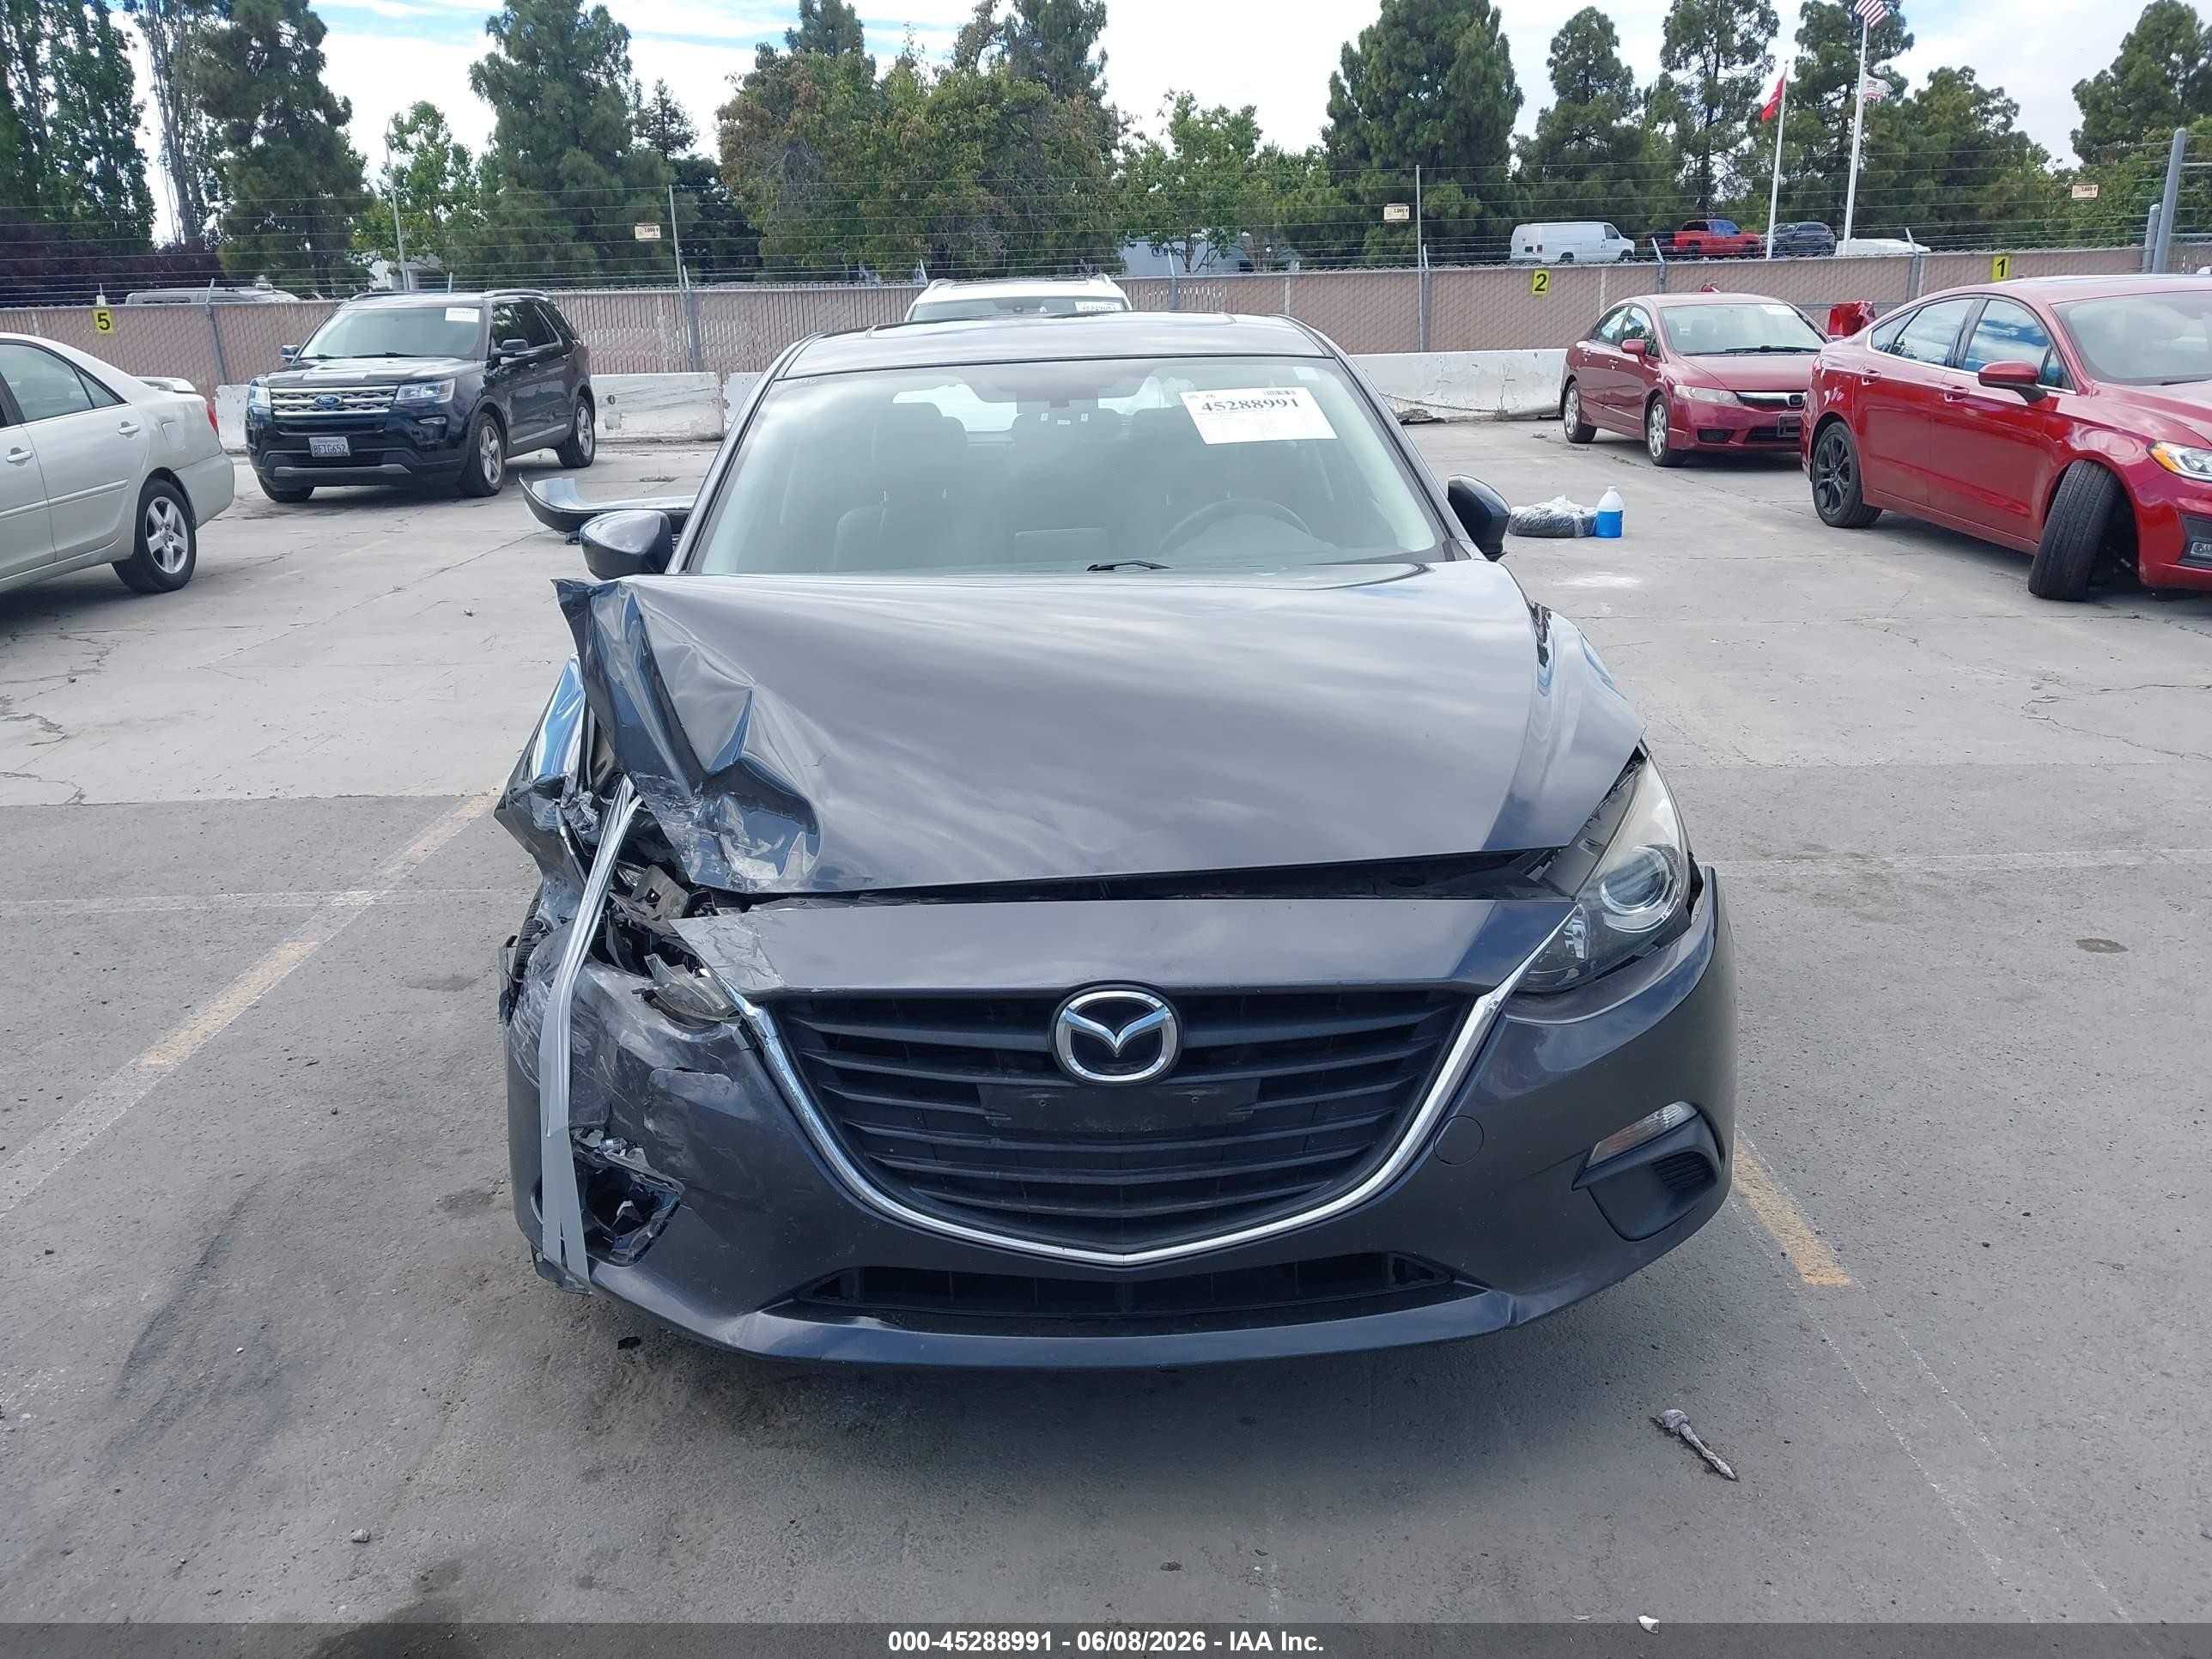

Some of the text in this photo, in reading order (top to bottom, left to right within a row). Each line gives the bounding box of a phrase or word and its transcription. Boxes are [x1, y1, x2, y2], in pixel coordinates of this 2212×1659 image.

[1996, 258, 2006, 277] 1
[1534, 273, 1547, 292] 2
[97, 312, 111, 331] 5
[1201, 398, 1300, 412] 45288991
